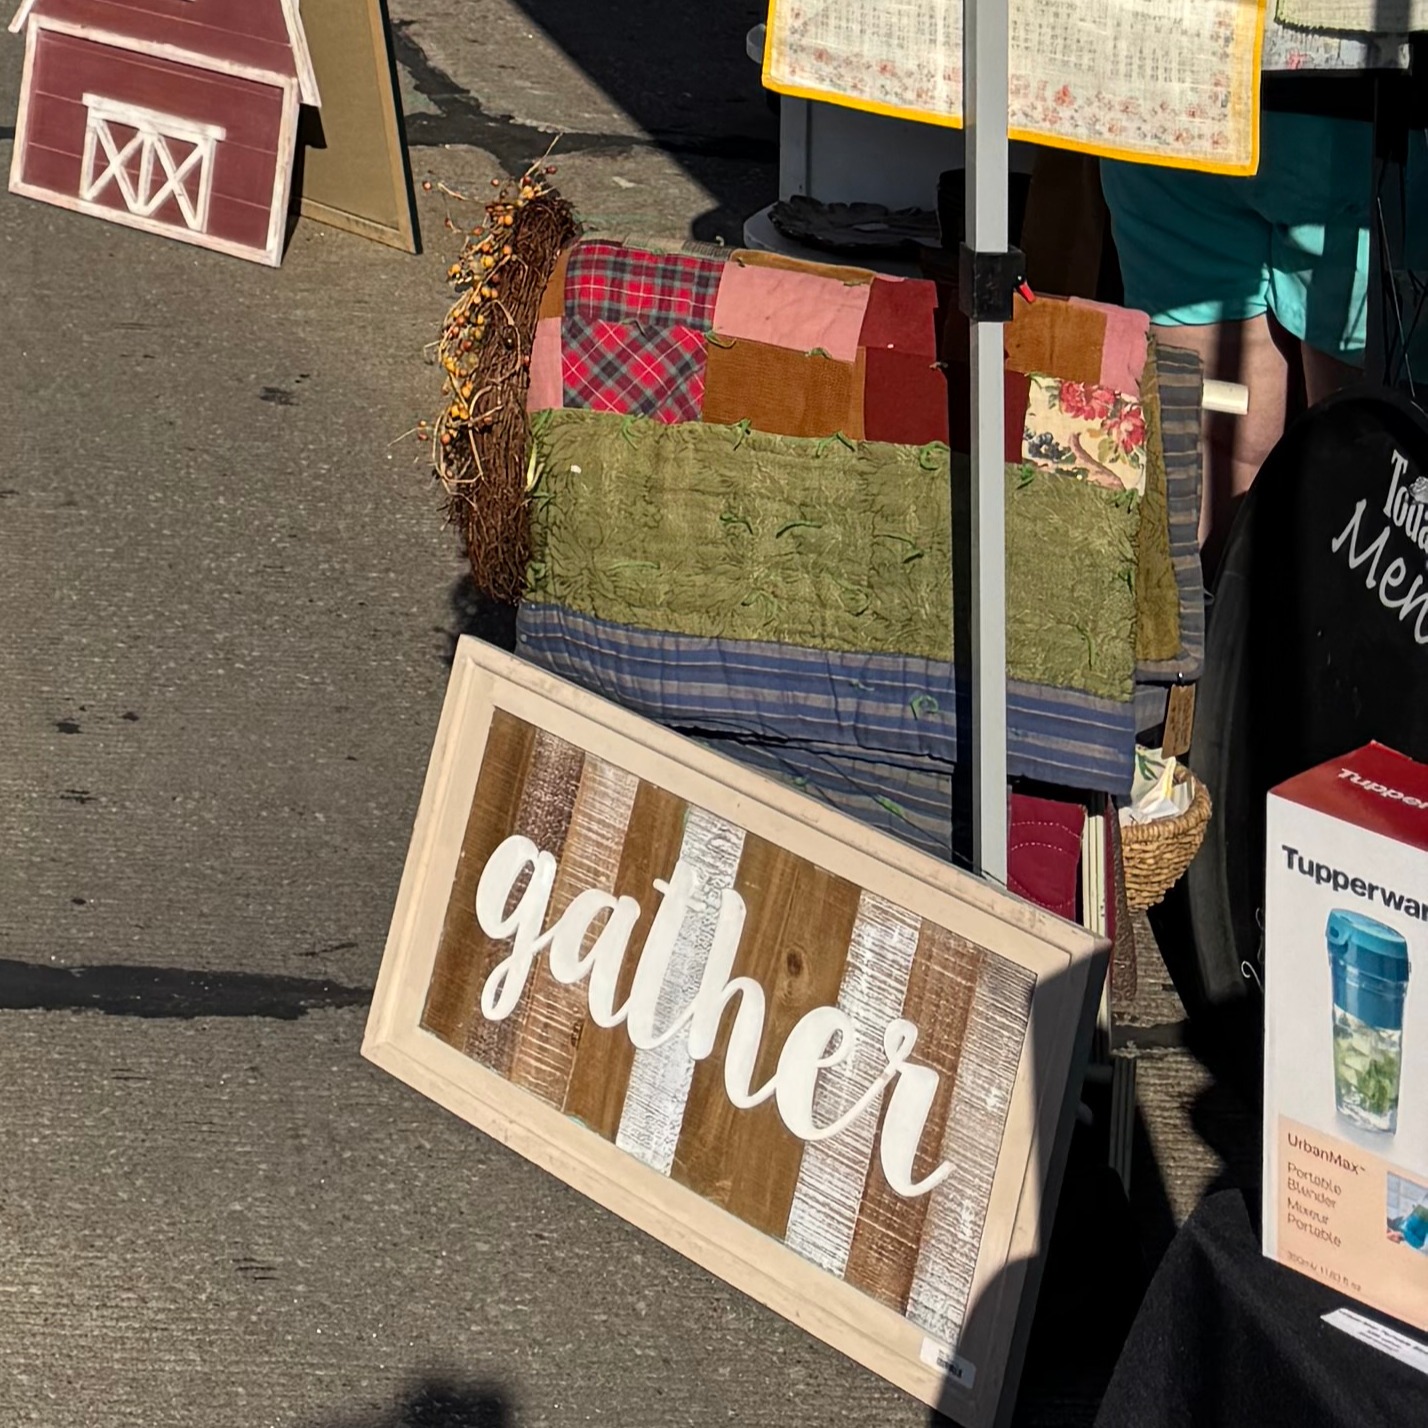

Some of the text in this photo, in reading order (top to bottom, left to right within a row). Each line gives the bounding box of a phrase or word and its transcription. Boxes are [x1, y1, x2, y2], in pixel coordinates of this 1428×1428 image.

[476, 834, 953, 1197] gather
[1287, 1161, 1342, 1196] Portable
[1287, 1177, 1337, 1209] Blender
[1287, 1213, 1342, 1247] Portable
